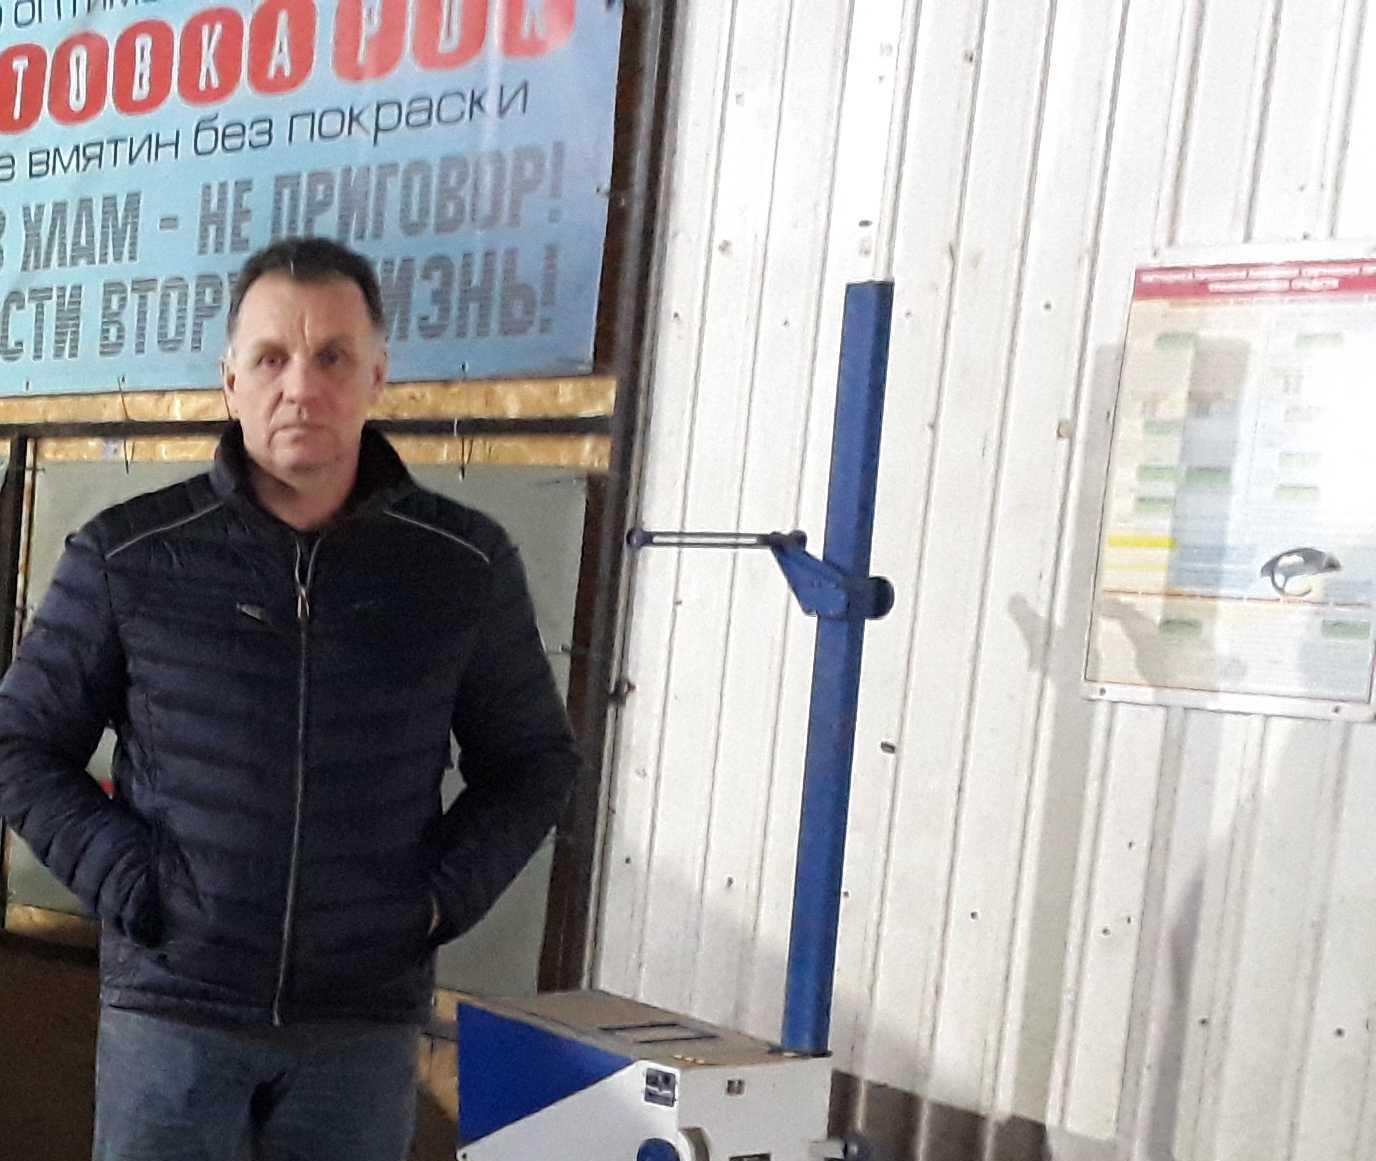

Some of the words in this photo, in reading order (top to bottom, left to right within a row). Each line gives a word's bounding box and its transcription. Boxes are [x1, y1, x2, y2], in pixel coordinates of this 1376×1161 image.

[29, 130, 180, 179] вмятин
[193, 113, 272, 156] без
[289, 80, 529, 146] покраски
[20, 191, 141, 272] ХЛАМ
[198, 178, 252, 255] НЕ
[270, 140, 564, 242] ПРИГОВОР!
[100, 272, 240, 357] ВТОР
[377, 243, 560, 341] ИЗНЬ!
